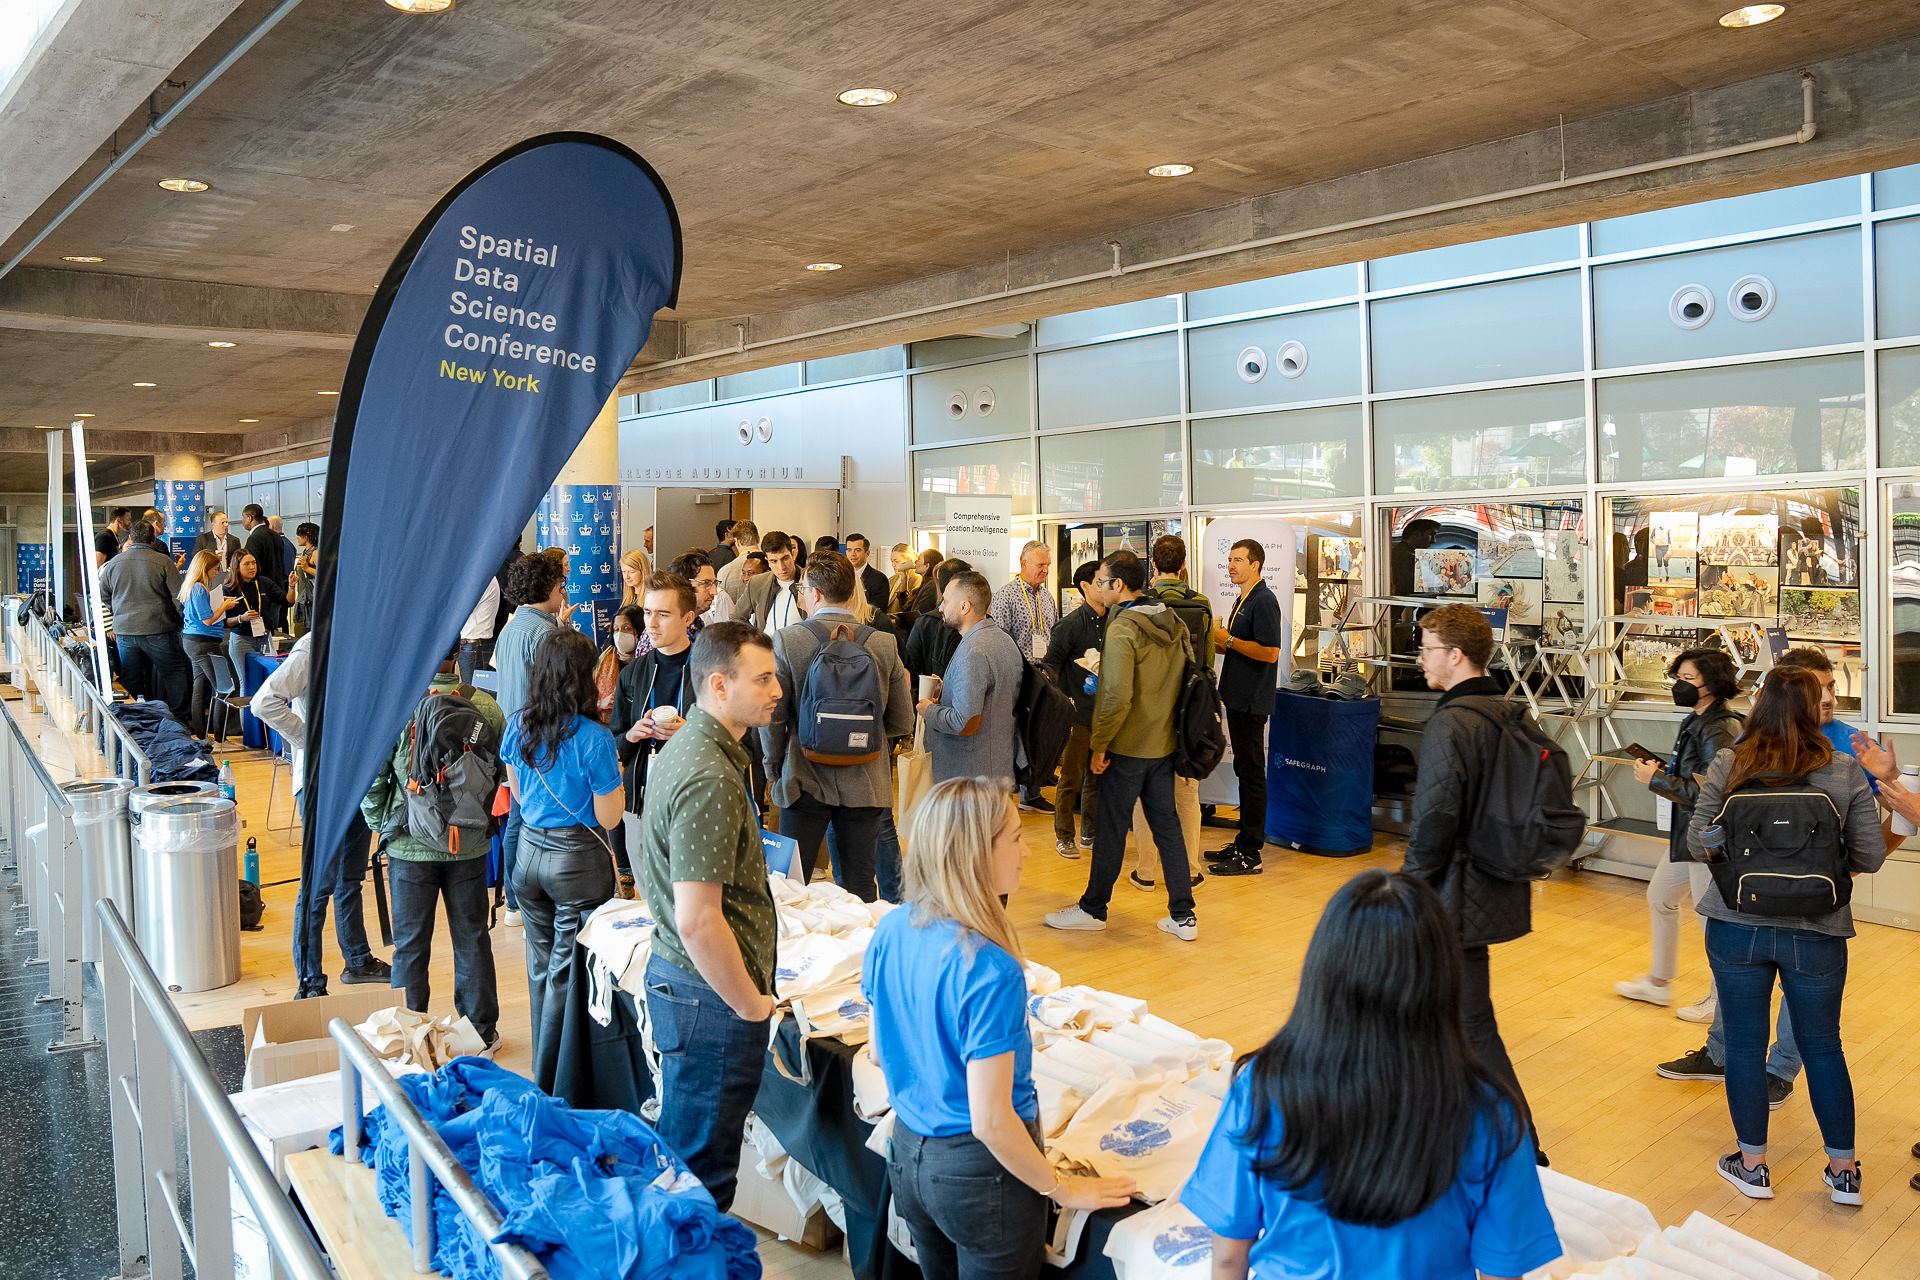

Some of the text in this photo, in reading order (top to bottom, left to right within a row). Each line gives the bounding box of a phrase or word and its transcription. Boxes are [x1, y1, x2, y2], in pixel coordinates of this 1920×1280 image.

[459, 225, 558, 268] Spatial
[454, 258, 519, 292] Data
[449, 291, 557, 332] Science
[444, 324, 597, 373] Conference
[439, 359, 541, 393] New York
[692, 467, 804, 479] AUDITORIUM
[953, 512, 1001, 521] Comprehensive
[971, 525, 1008, 535] Intelligence
[951, 547, 972, 556] Across
[1284, 757, 1327, 773] SAFEGRAPH
